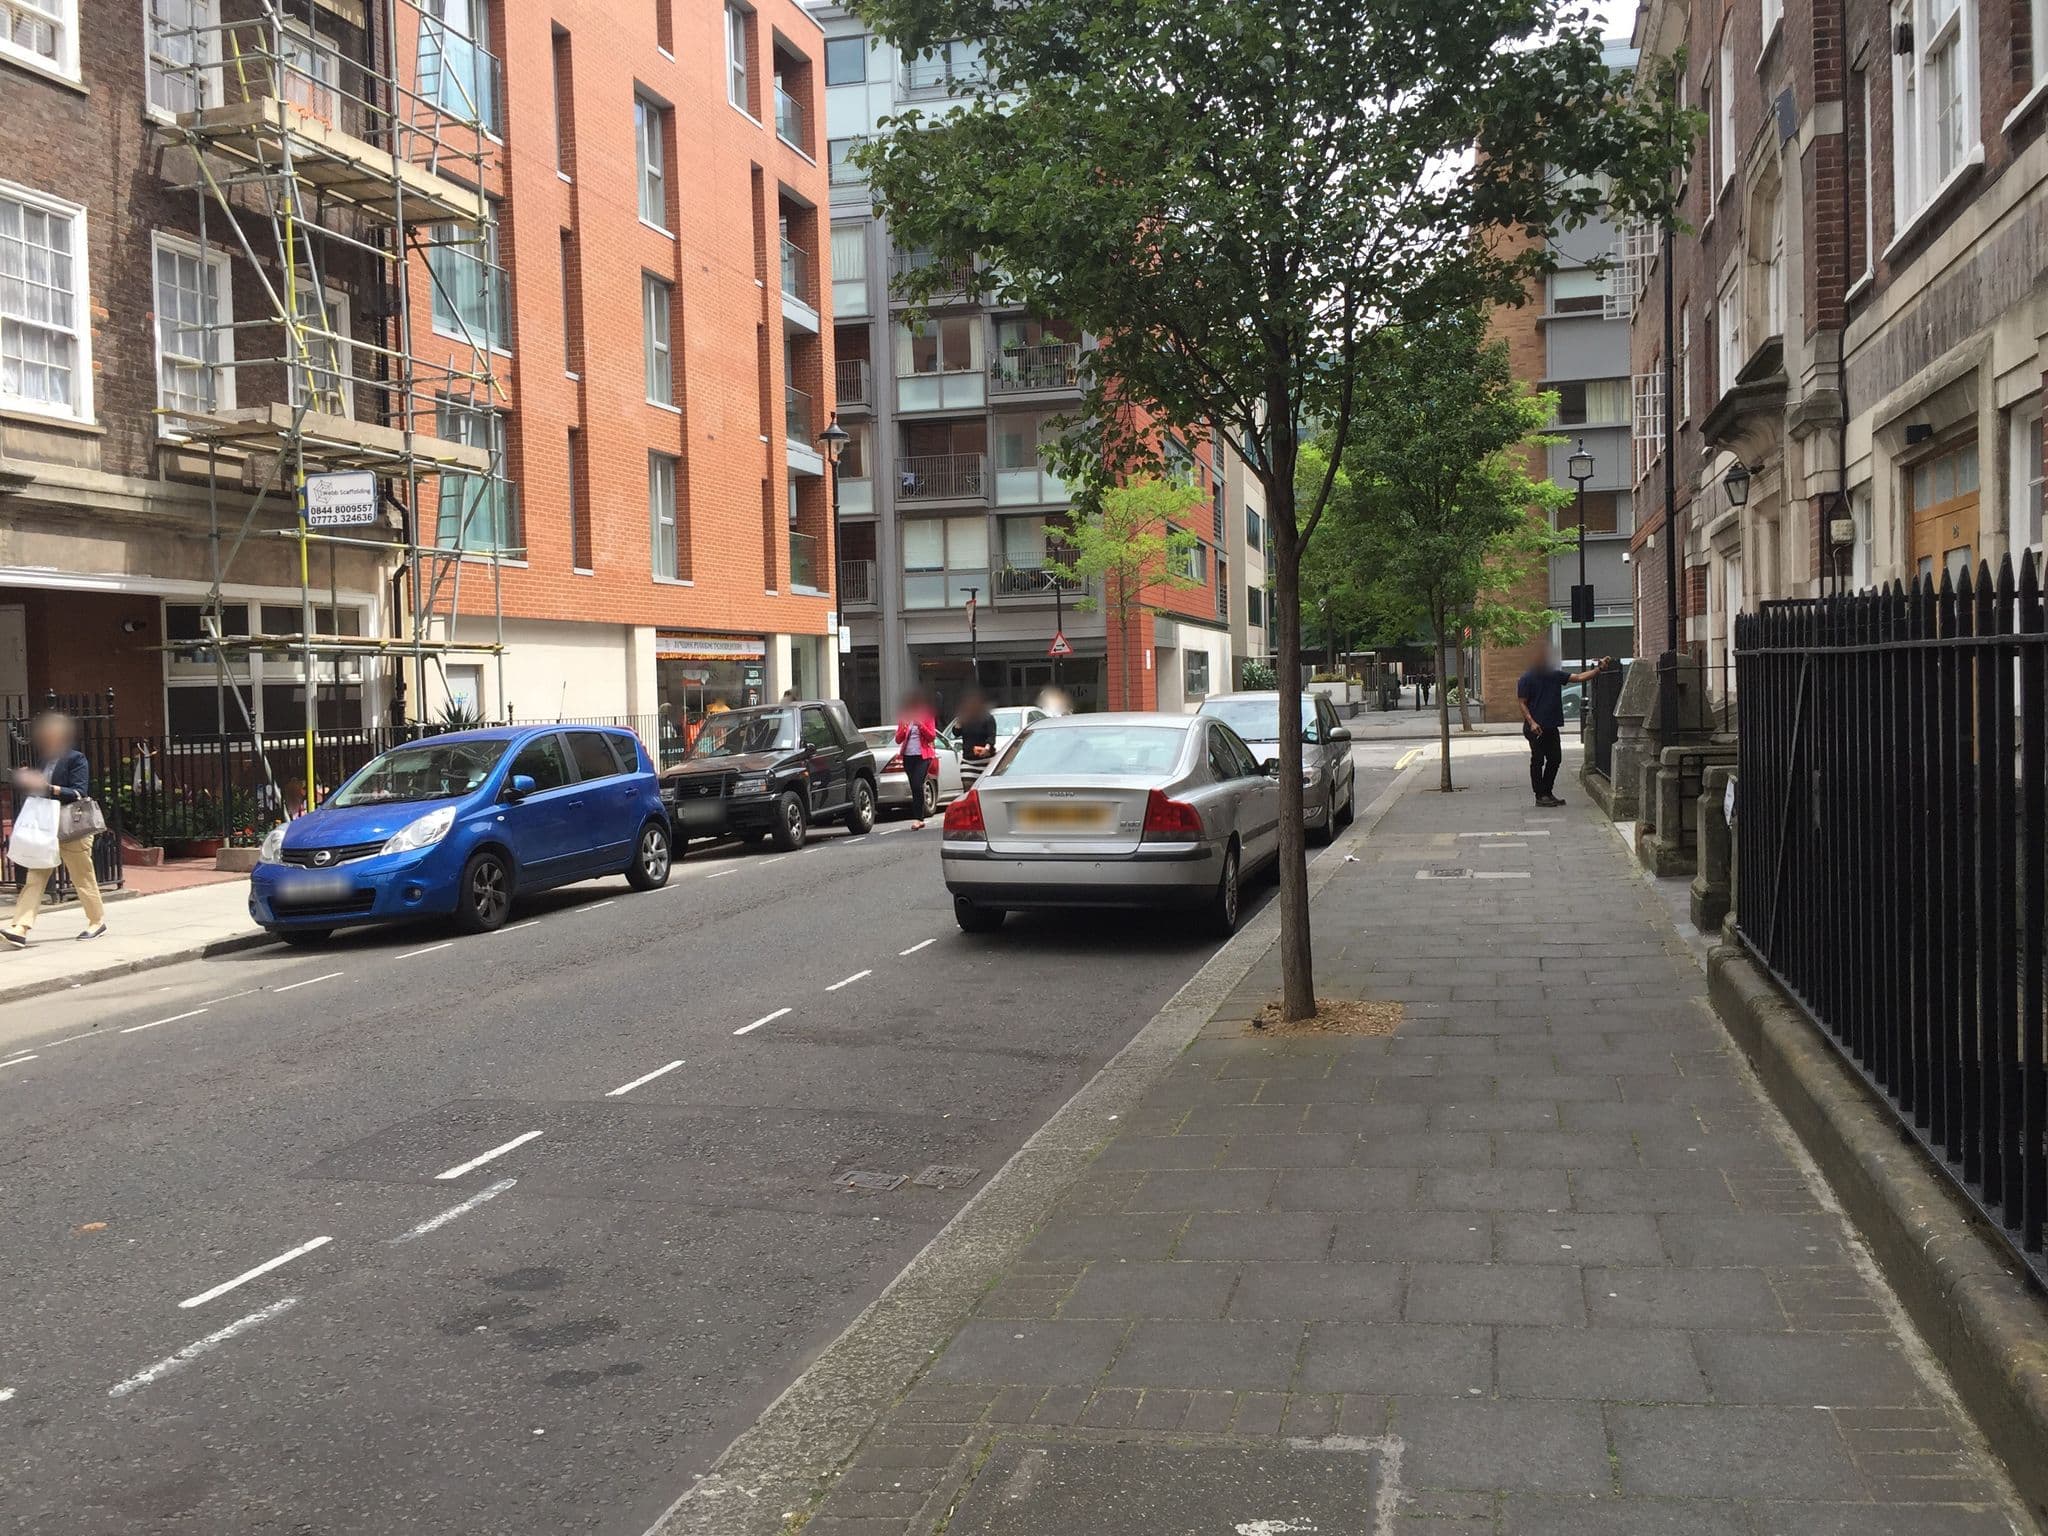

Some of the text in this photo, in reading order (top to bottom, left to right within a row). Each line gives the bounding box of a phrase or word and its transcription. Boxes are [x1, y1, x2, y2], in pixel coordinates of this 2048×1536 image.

[310, 504, 373, 515] 0844 8009557
[311, 513, 373, 524] 07773 324636
